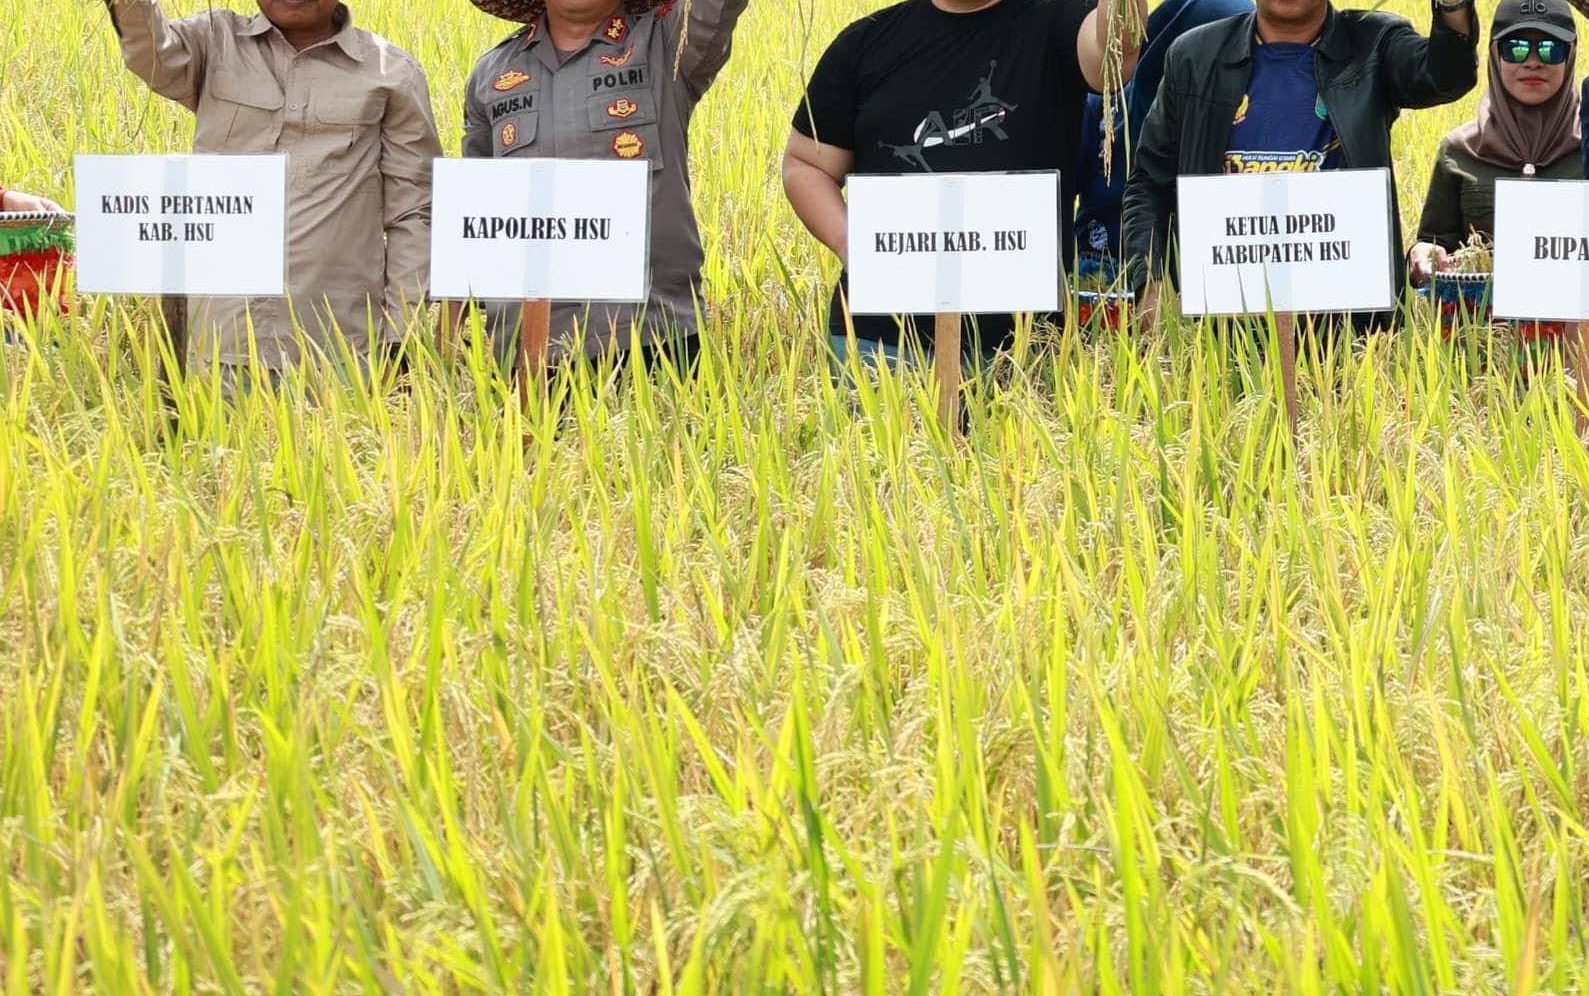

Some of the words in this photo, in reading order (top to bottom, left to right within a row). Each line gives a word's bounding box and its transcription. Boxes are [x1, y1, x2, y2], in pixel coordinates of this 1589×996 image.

[592, 68, 644, 92] POLRI
[492, 94, 533, 121] AGUS.N
[103, 195, 149, 214] KADIS
[161, 195, 252, 214] PERTANIAN
[139, 222, 178, 241] KAB.
[184, 223, 214, 242] HSU
[463, 216, 567, 240] KAPOLRES
[574, 217, 611, 240] HSU
[1225, 215, 1280, 237] KETUA
[1285, 213, 1336, 235] DPRD
[875, 232, 937, 255] KEJARI
[943, 231, 986, 252] KAB.
[994, 230, 1027, 251] HSU
[1212, 242, 1313, 265] KABUPATEN
[1319, 241, 1351, 261] HSU
